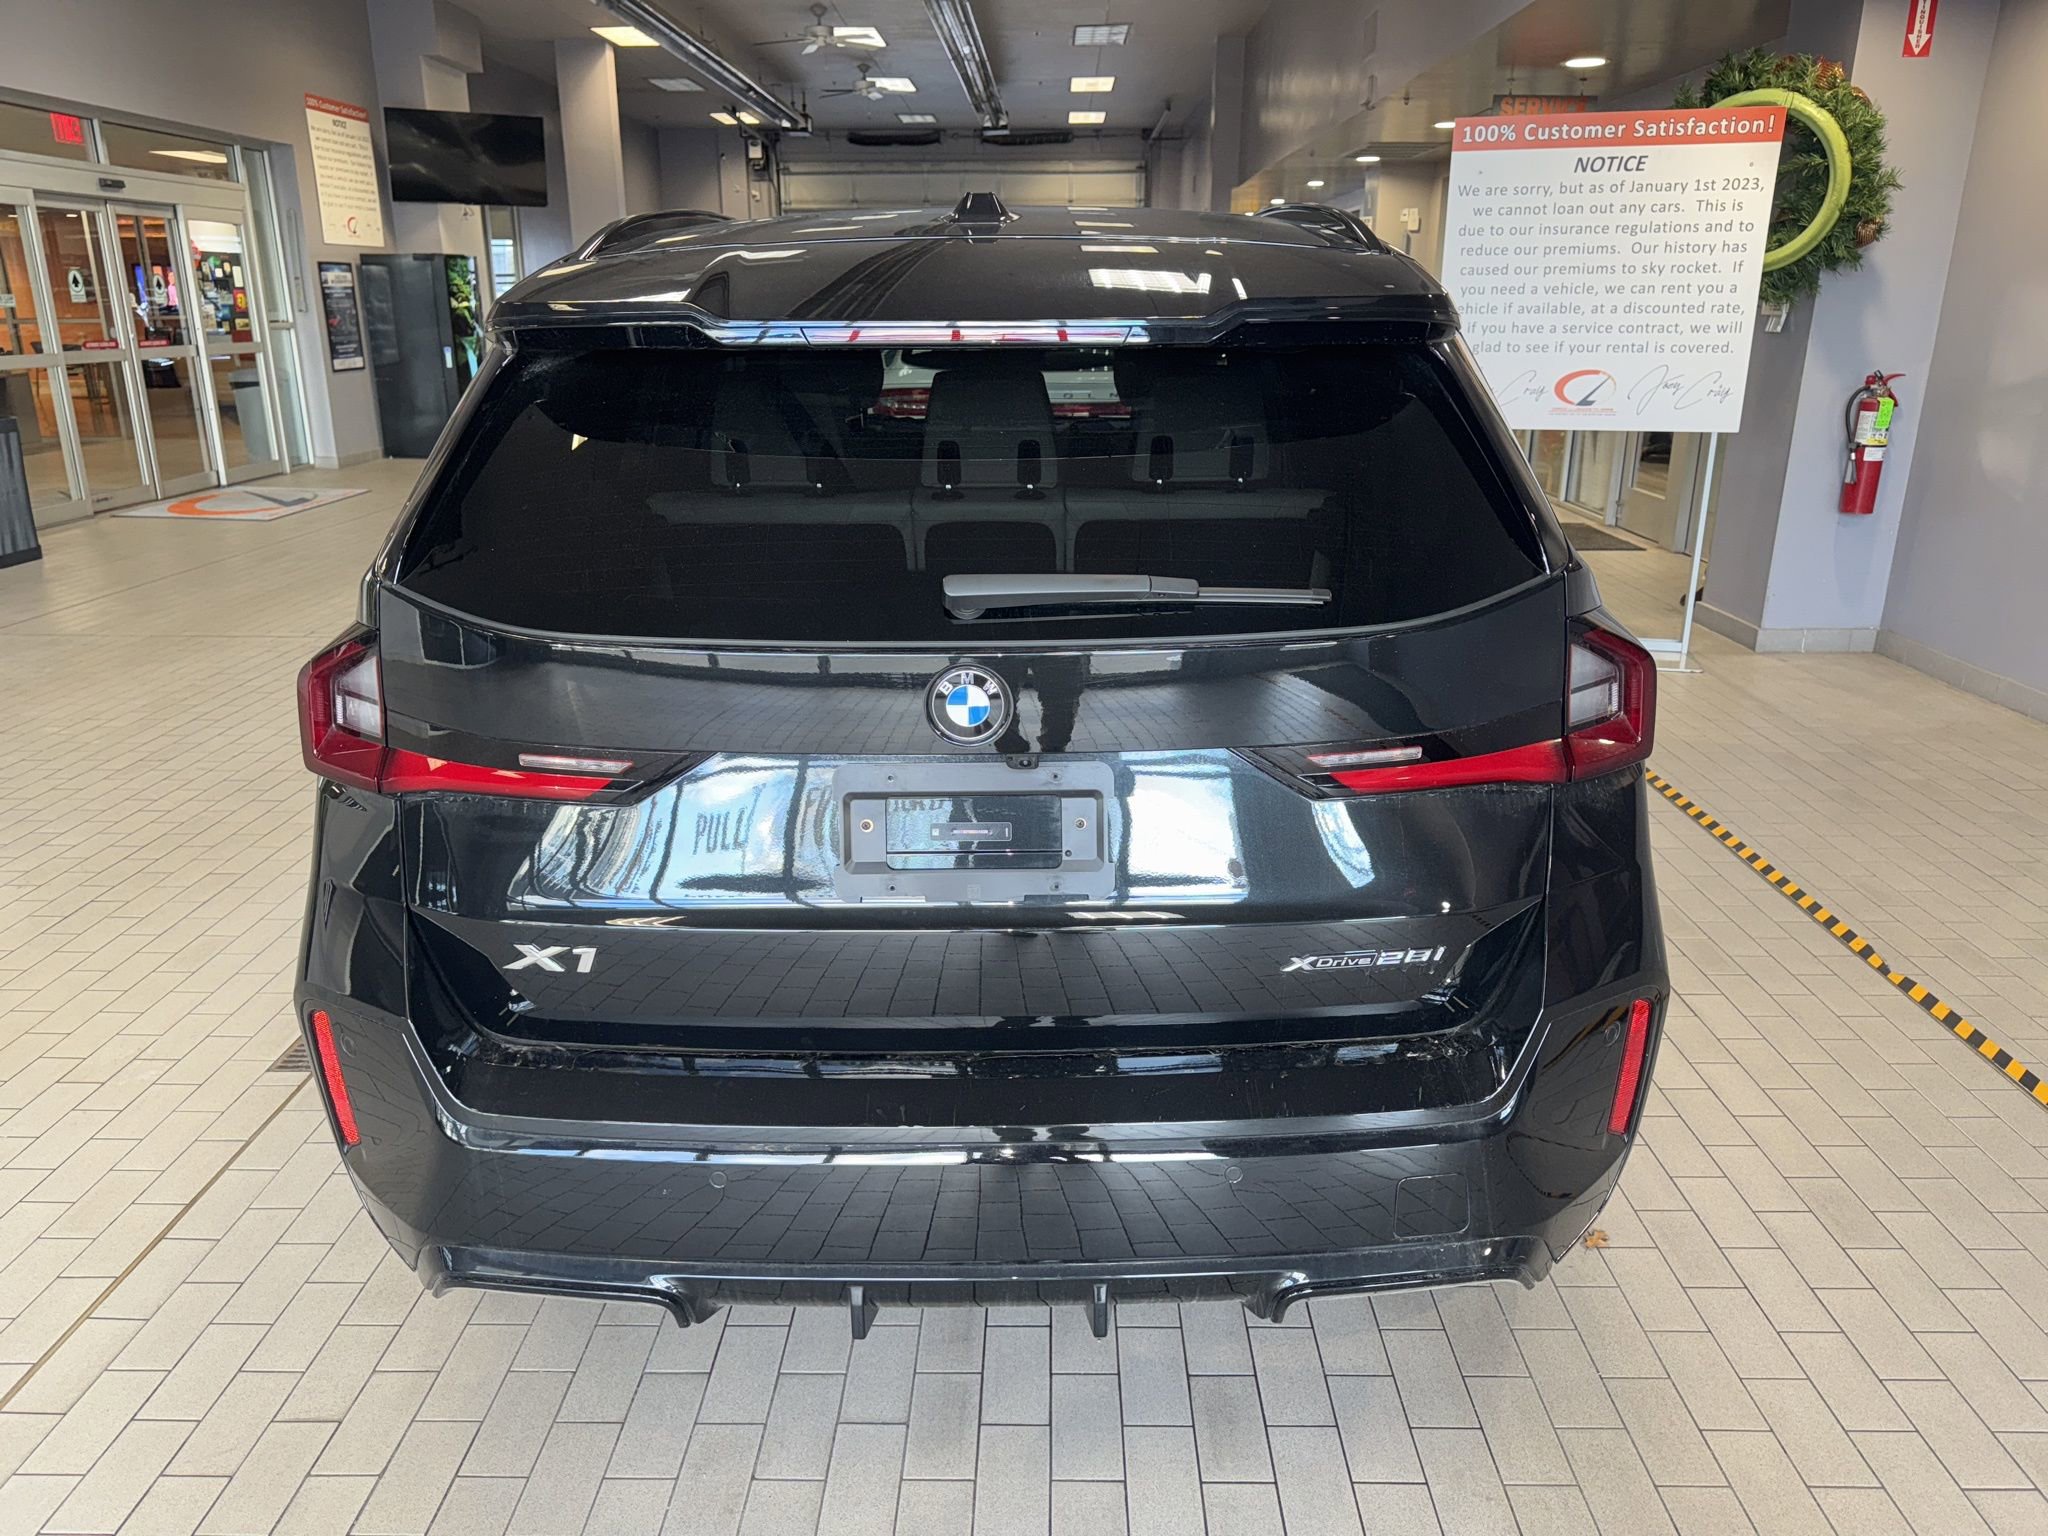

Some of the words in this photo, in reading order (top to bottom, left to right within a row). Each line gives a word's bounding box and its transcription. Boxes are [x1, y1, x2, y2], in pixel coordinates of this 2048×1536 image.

[1462, 124, 1516, 143] 100%
[1524, 123, 1626, 140] Customer
[1633, 114, 1775, 137] Satisfaction!
[1573, 154, 1649, 175] NOTICE
[1457, 184, 1481, 197] We
[1485, 186, 1508, 197] are
[1512, 185, 1553, 198] sorry,
[1559, 181, 1585, 195] but
[1588, 183, 1605, 194] as
[1609, 179, 1627, 194] of
[1628, 180, 1689, 195] January
[1693, 178, 1717, 192] 1st
[1721, 177, 1765, 193] 2023,
[1472, 206, 1493, 217] we
[1497, 203, 1548, 217] cannot
[1552, 201, 1584, 215] loan
[1589, 202, 1615, 215] out
[1619, 203, 1647, 217] any
[1650, 202, 1685, 214] cars.
[1695, 198, 1727, 213] This
[1731, 198, 1744, 212] is
[1458, 223, 1485, 237] due
[1489, 225, 1505, 237] to
[1508, 226, 1534, 236] our
[1538, 223, 1610, 236] insurance
[1615, 220, 1700, 237] regulations
[1704, 218, 1734, 233] and
[1738, 220, 1755, 233] to
[1460, 243, 1509, 257] reduce
[1513, 246, 1539, 256] our
[1543, 242, 1621, 258] premiums.
[1631, 241, 1660, 255] Our
[1663, 240, 1717, 257] history
[1721, 239, 1748, 253] has
[1460, 263, 1510, 276] caused
[1513, 265, 1539, 276] our
[1543, 262, 1616, 278] premiums
[1621, 263, 1637, 275] to
[1641, 261, 1666, 277] sky
[1670, 260, 1722, 274] rocket.
[1732, 259, 1745, 273] If
[1460, 286, 1486, 298] you
[1490, 282, 1526, 296] need
[1530, 285, 1538, 295] a
[1543, 282, 1599, 297] vehicle,
[1604, 284, 1626, 295] we
[1630, 284, 1656, 295] can
[1660, 282, 1693, 295] rent
[1696, 283, 1725, 297] you
[1729, 283, 1738, 294] a
[1458, 302, 1499, 315] ehicle
[1503, 301, 1514, 315] if
[1517, 301, 1585, 316] available,
[1590, 303, 1606, 315] at
[1609, 304, 1618, 314] a
[1623, 300, 1706, 315] discounted
[1710, 302, 1745, 316] rate,
[1467, 321, 1477, 334] if
[1481, 324, 1506, 336] you
[1511, 321, 1545, 334] have
[1549, 324, 1557, 334] a
[1561, 321, 1614, 334] service
[1618, 322, 1684, 336] contract,
[1689, 324, 1711, 334] we
[1716, 320, 1743, 334] will
[1472, 340, 1503, 356] glad
[1506, 342, 1521, 353] to
[1525, 343, 1550, 353] see
[1554, 340, 1565, 353] if
[1568, 343, 1602, 356] your
[1606, 340, 1650, 354] rental
[1654, 341, 1665, 354] is
[1670, 340, 1734, 354] covered.
[939, 672, 997, 696] BMW
[502, 943, 599, 974] X1
